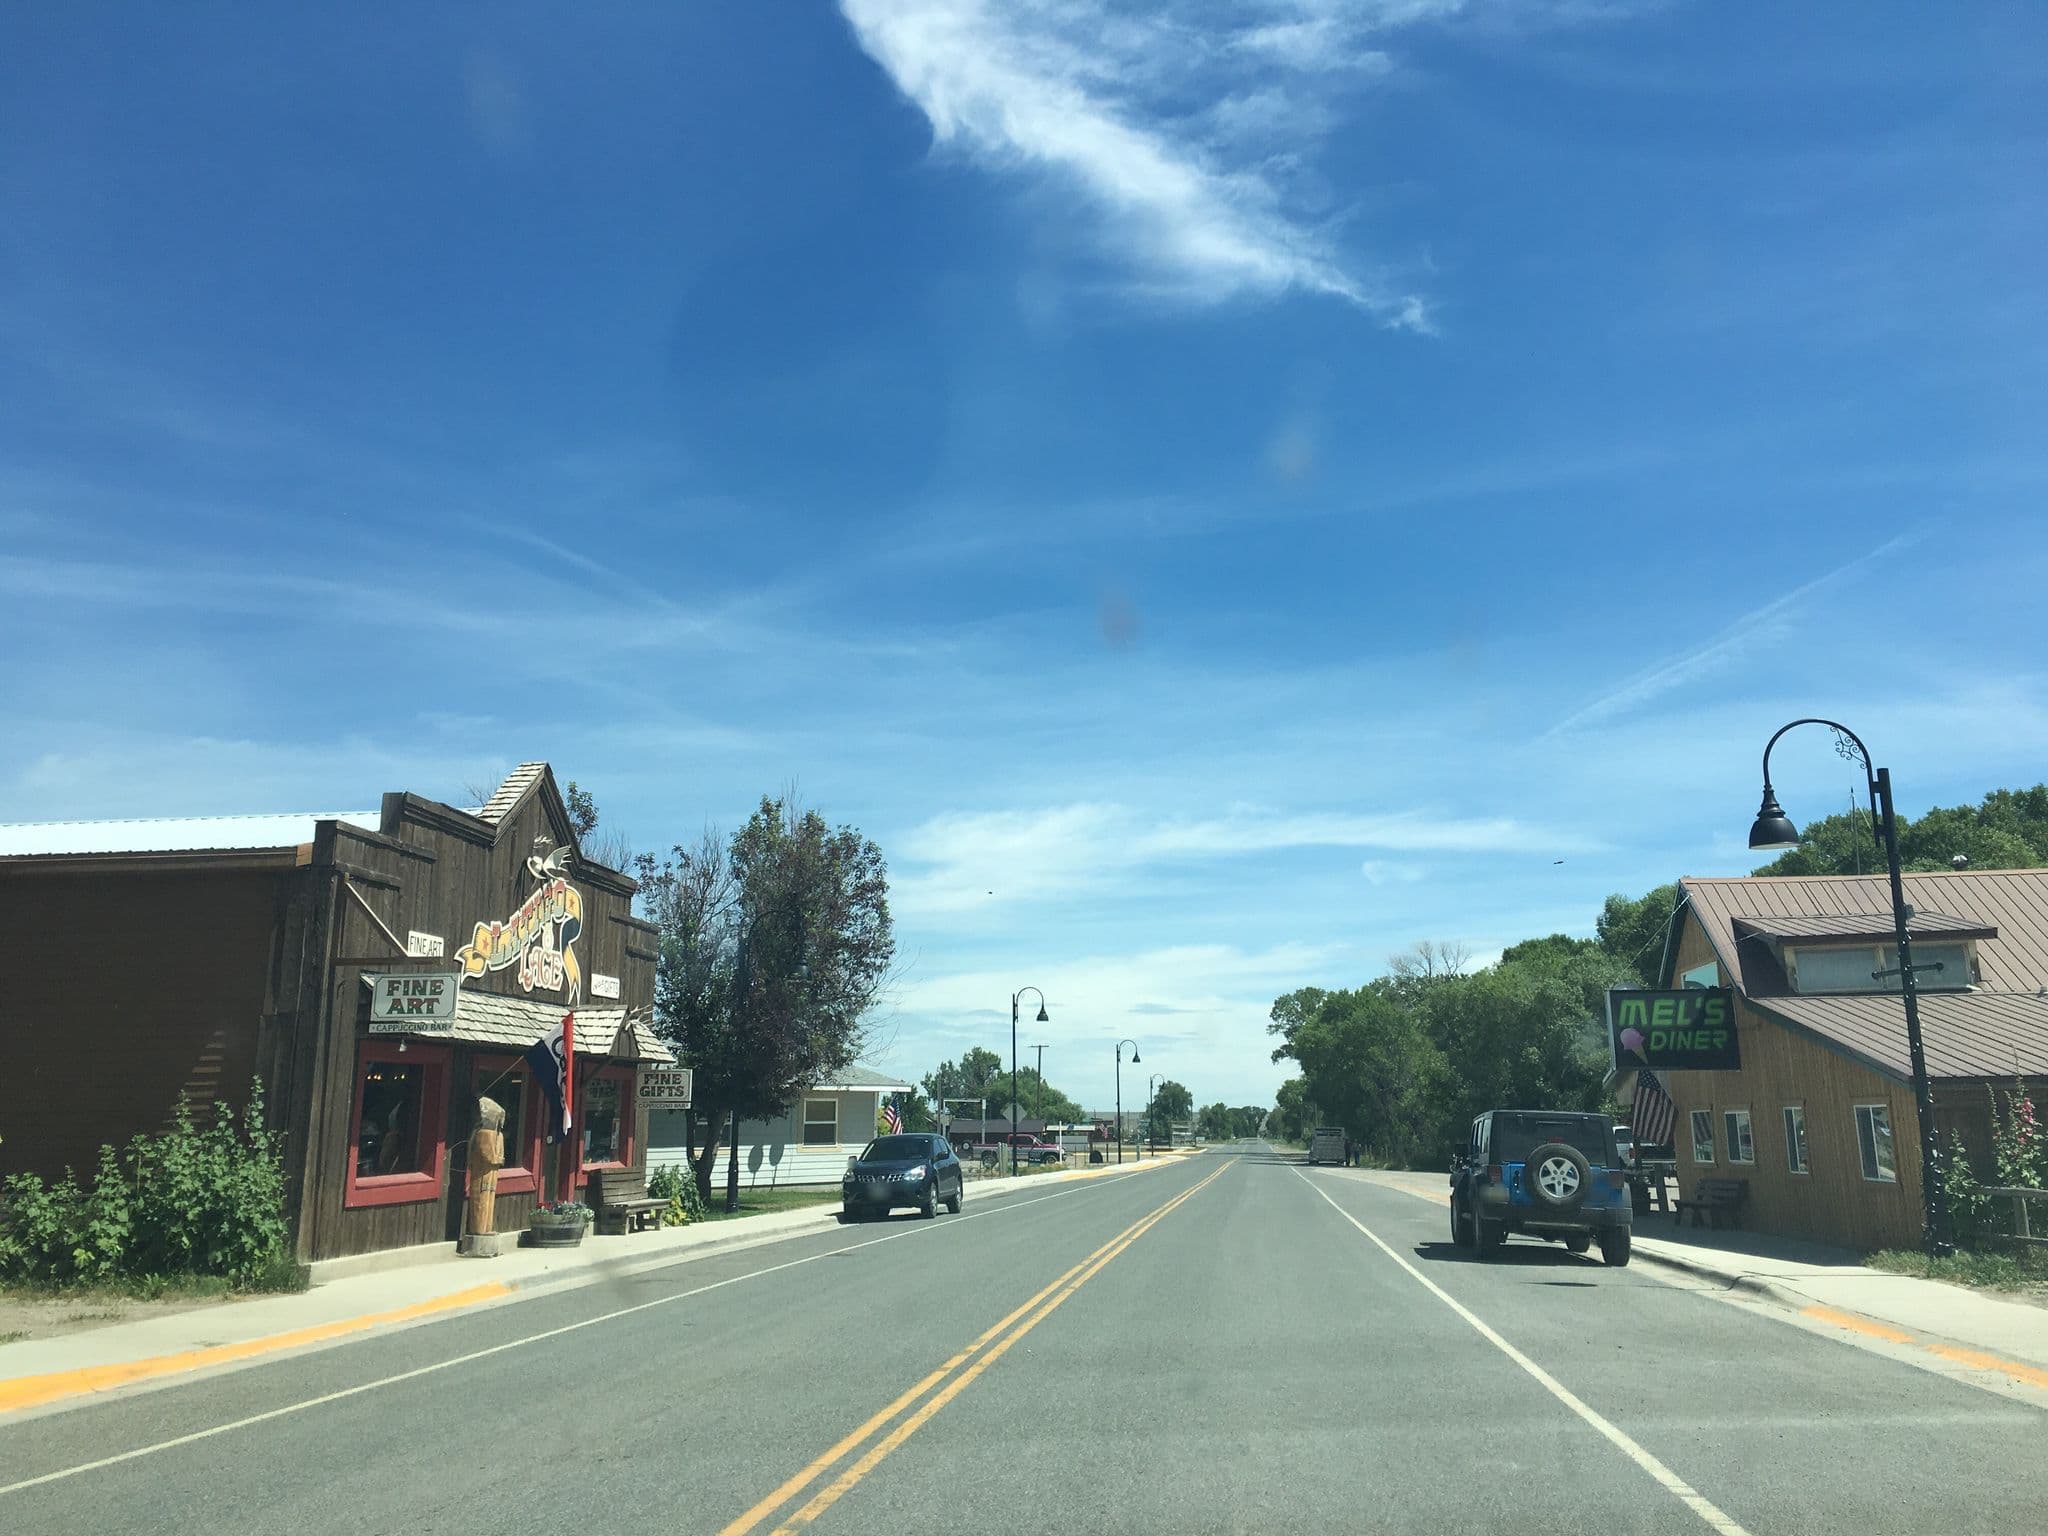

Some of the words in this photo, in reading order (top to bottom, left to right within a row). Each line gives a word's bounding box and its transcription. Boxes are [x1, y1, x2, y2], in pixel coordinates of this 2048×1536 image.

[410, 935, 427, 955] FINE
[427, 940, 443, 957] ART
[519, 946, 563, 991] LACE
[386, 980, 445, 996] FINE
[386, 998, 441, 1015] ART
[1618, 997, 1726, 1026] MEL'S
[376, 1023, 428, 1032] CAPPUCCINO
[430, 1023, 448, 1032] BAR
[1650, 1031, 1728, 1050] DINER
[643, 1073, 683, 1085] FINE
[640, 1085, 685, 1098] GIFTS
